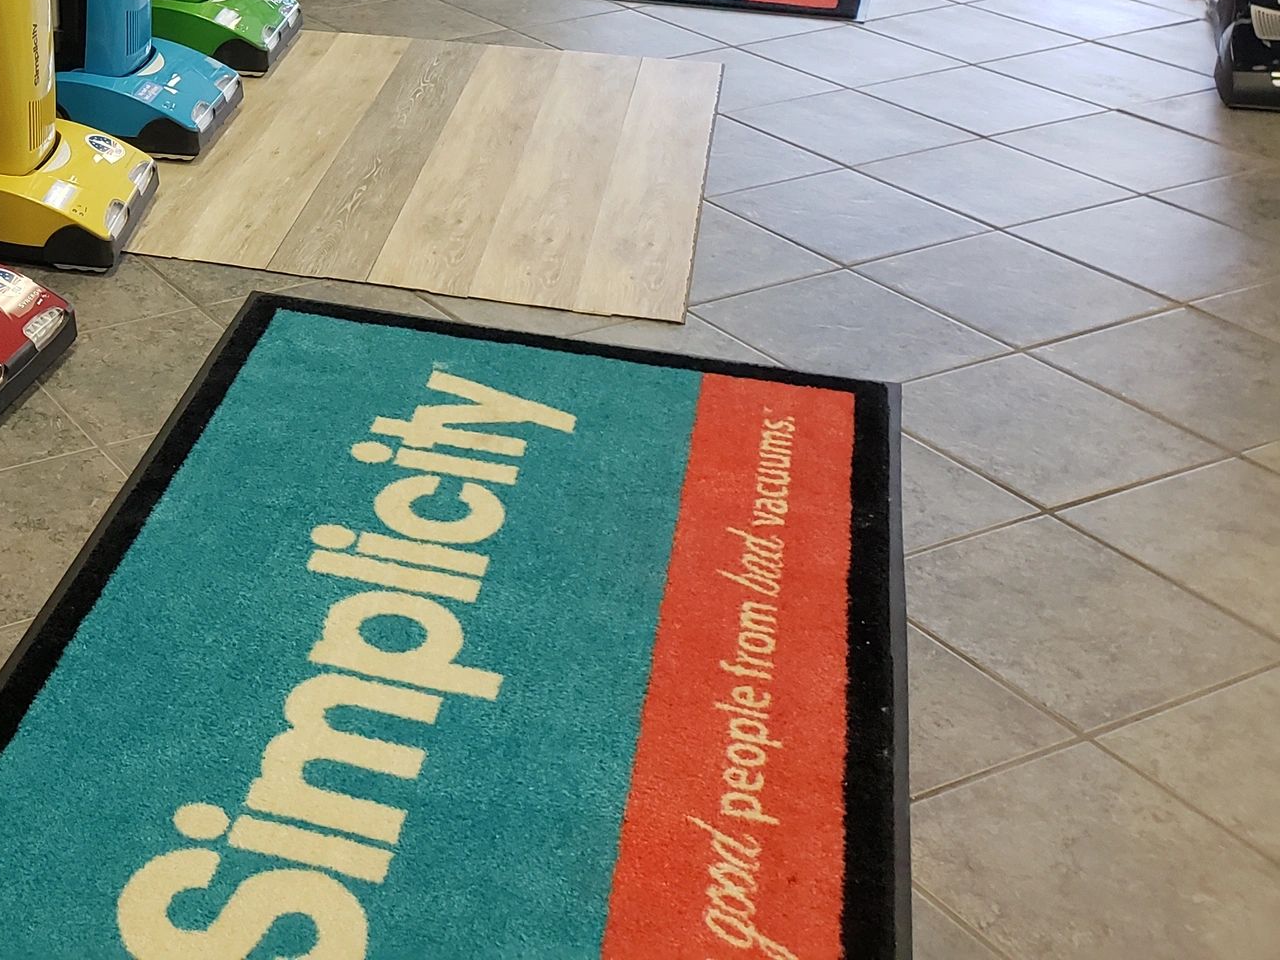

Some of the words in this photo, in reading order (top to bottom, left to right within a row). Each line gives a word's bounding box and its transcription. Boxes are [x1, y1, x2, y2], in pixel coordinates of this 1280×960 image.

[33, 23, 42, 86] Simplicity
[752, 414, 796, 527] vacuums.
[715, 526, 786, 598] bad
[116, 367, 579, 960] Simplicity
[718, 600, 779, 680] from
[713, 684, 784, 825] people
[686, 814, 801, 960] good
